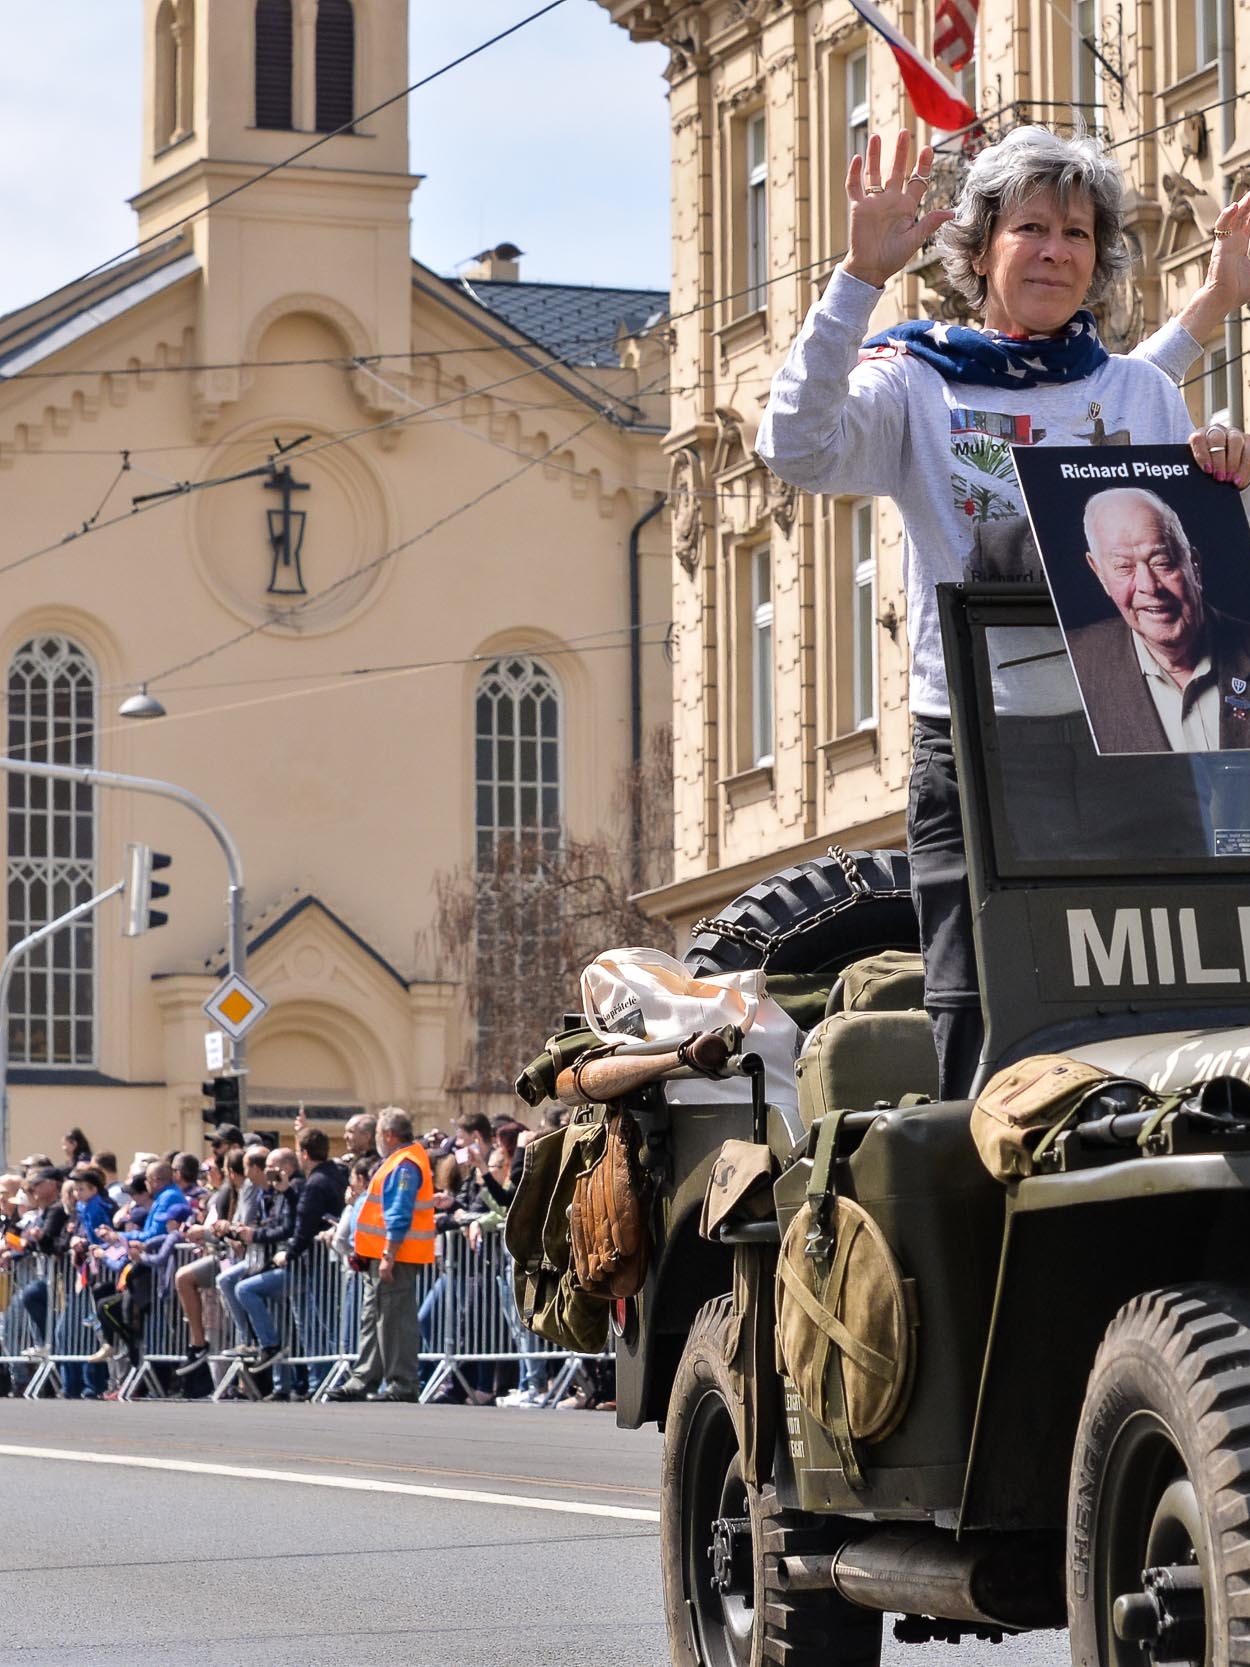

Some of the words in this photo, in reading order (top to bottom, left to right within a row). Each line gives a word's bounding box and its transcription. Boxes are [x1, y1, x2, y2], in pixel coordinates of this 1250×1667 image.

[1060, 462, 1130, 479] Richard
[1132, 462, 1190, 480] Pieper
[1072, 1448, 1102, 1601] CHENG
